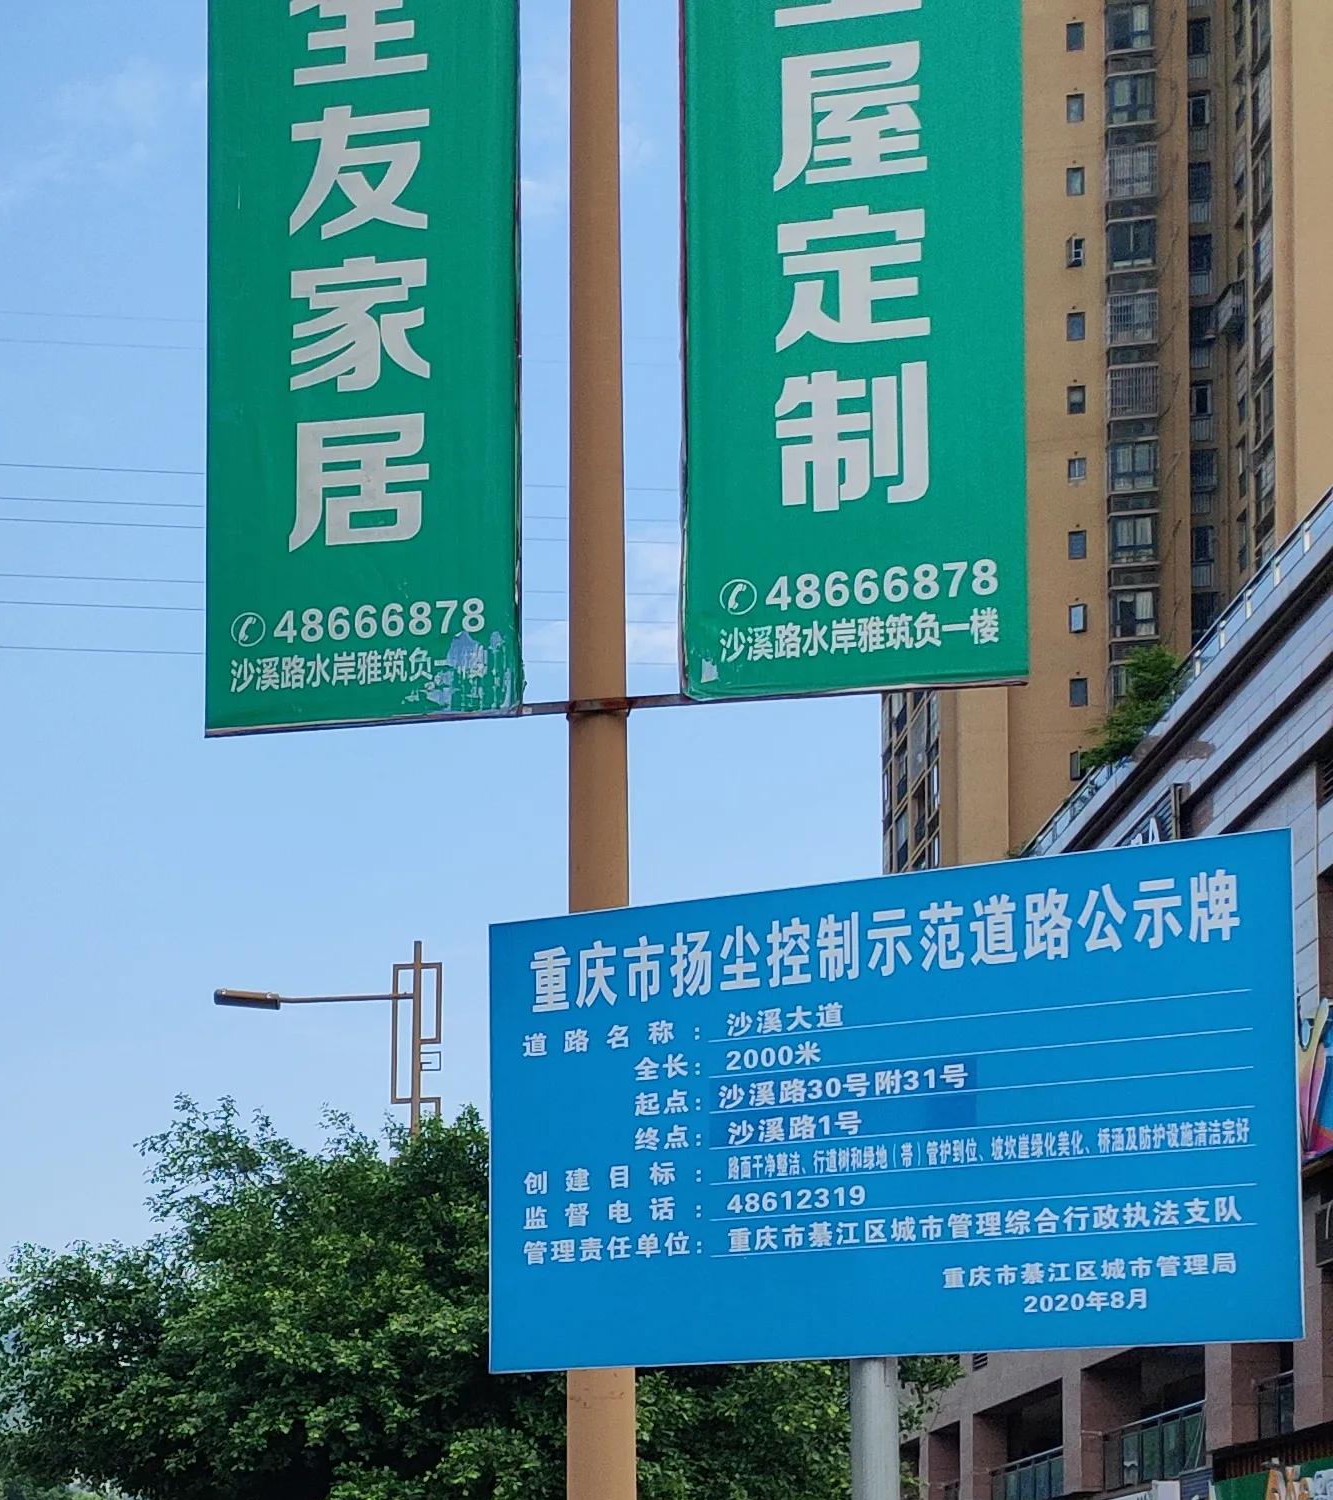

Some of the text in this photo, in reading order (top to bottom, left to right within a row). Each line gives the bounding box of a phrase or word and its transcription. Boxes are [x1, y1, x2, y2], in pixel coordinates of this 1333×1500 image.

[288, 0, 432, 553] 全友家居
[773, 0, 931, 514] 屋定制
[765, 558, 999, 611] 48666878
[273, 597, 485, 644] 48666878
[720, 607, 1000, 663] 沙溪路水岸雅筑负一楼
[530, 868, 1241, 1013] 重庆市扬尘控制示范道路公示牌
[727, 1002, 844, 1038] 沙溪大道
[726, 1041, 821, 1071] 2000米
[718, 1063, 969, 1110] 沙溪路30号附31号
[727, 1110, 862, 1145] 沙溪路1号
[727, 1184, 867, 1214] 48612319
[728, 1196, 1242, 1254] 重庆市綦江区城市管理综合行政执法支队
[942, 1252, 1237, 1289] 重庆市綦江区城市管理局
[1024, 1288, 1148, 1314] 2020年8月
